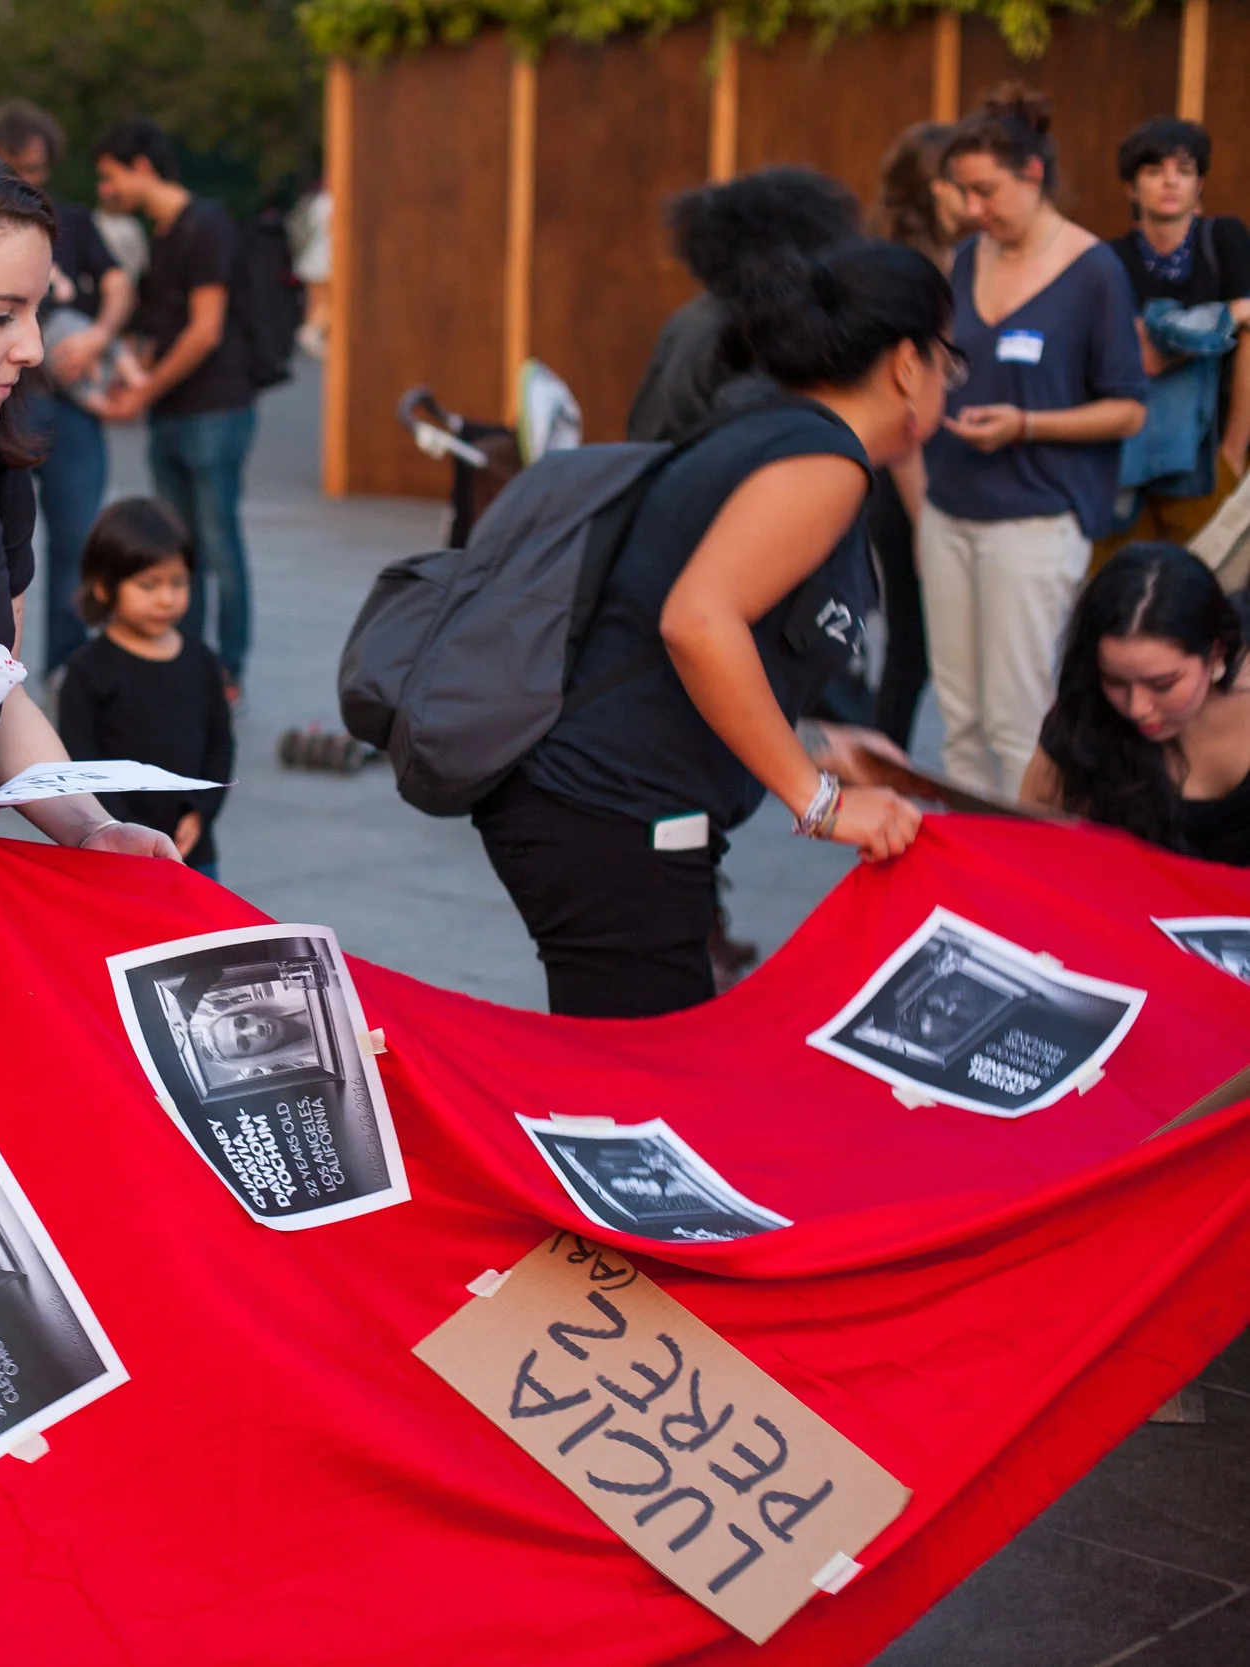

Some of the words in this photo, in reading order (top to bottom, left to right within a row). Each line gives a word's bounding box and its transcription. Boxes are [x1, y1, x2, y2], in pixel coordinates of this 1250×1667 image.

[276, 1102, 295, 1134] OLD
[350, 1077, 369, 1110] 2016
[252, 1114, 298, 1197] YOCHUM
[286, 1135, 311, 1180] YEARS
[297, 1096, 325, 1164] ANGELES,
[311, 1097, 346, 1185] CALIFORNIA
[207, 1118, 267, 1209] QUARTNEY
[232, 1133, 268, 1190] DAVIA
[304, 1179, 321, 1198] 32
[317, 1166, 338, 1193] LOS
[547, 1291, 834, 1543] PEREZ
[509, 1348, 766, 1595] LUCIA
